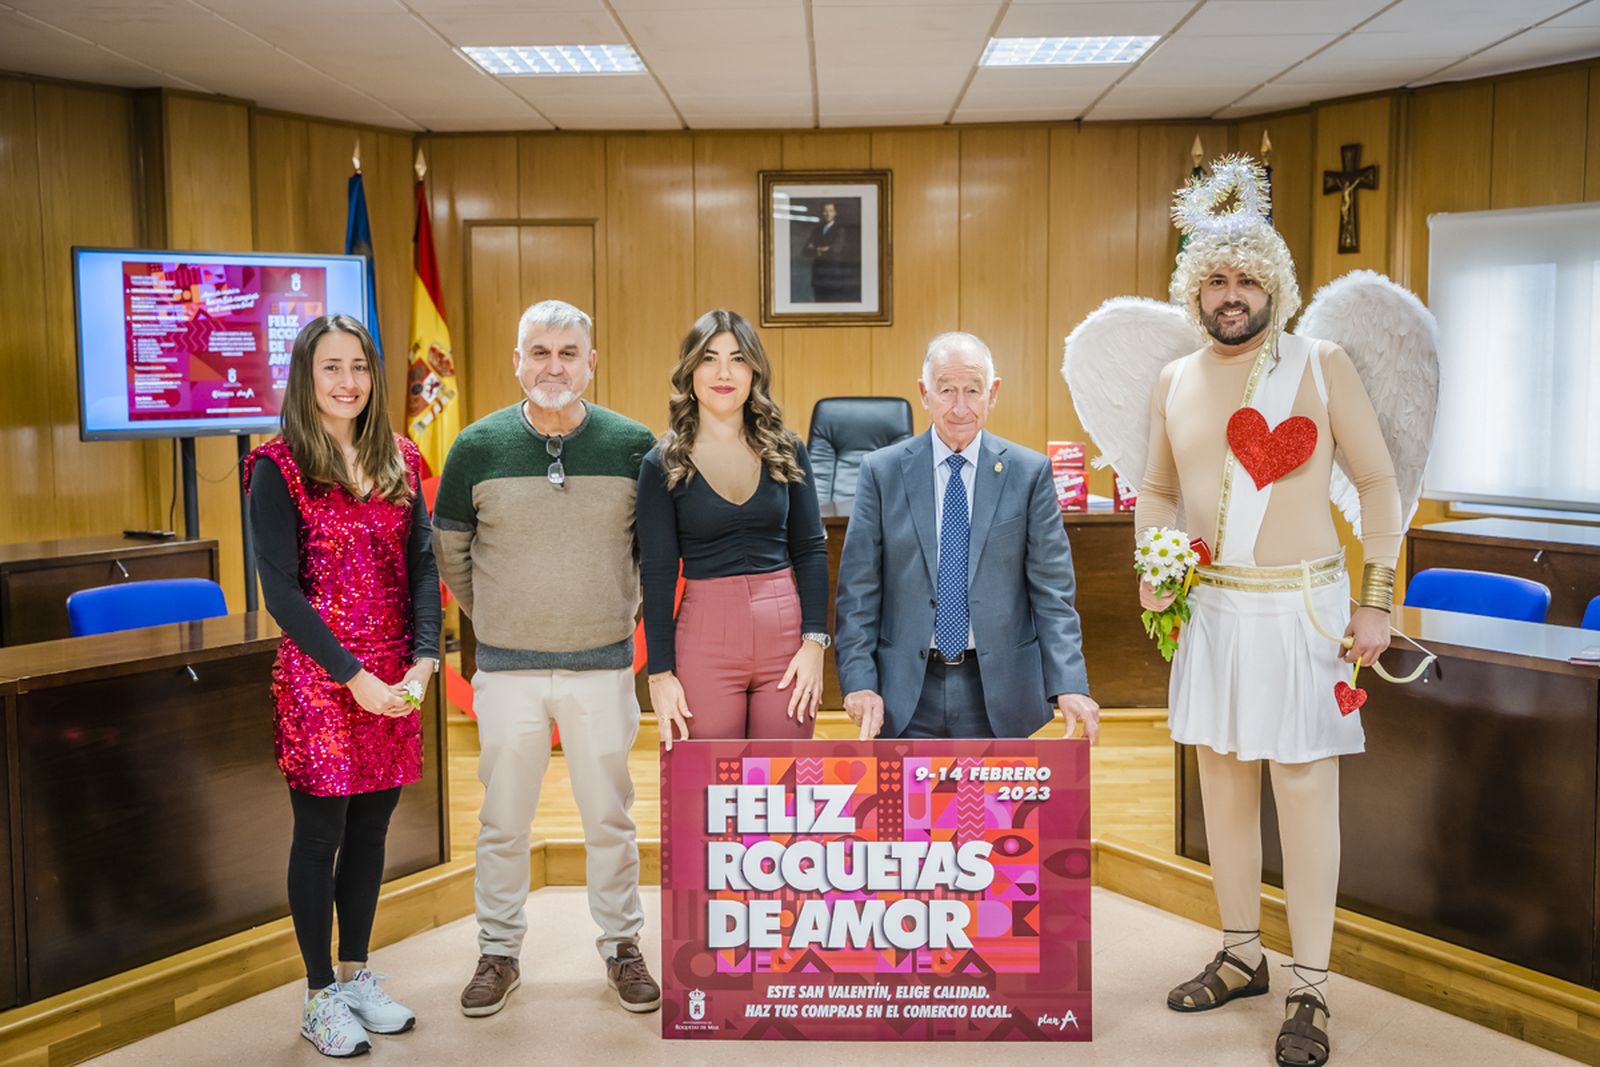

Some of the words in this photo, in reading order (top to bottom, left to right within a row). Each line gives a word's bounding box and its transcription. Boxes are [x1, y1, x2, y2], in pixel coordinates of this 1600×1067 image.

[268, 315, 299, 327] FELIZ
[269, 341, 285, 352] DE
[915, 767, 963, 782] 9-14
[969, 767, 1051, 782] FEBRERO
[997, 786, 1051, 801] 2023
[708, 784, 858, 833] FELIZ
[708, 840, 995, 893] ROQUETAS
[708, 899, 782, 949] DE
[788, 898, 974, 950] AMOR
[767, 985, 796, 999] ESTE
[798, 985, 824, 999] SAN
[828, 982, 892, 1001] VALENTÍN,
[896, 985, 931, 999] ELIGE
[933, 985, 990, 999] CALIDAD.
[745, 1004, 771, 1018] HAZ
[774, 1004, 798, 1018] TUS
[801, 1004, 863, 1018] COMPRAS
[866, 1005, 883, 1018] EN
[886, 1005, 900, 1018] EL
[903, 1005, 968, 1018] COMERCIO
[970, 1005, 1012, 1018] LOCAL.
[1037, 1013, 1060, 1027] plan
[1059, 1009, 1079, 1031] A
